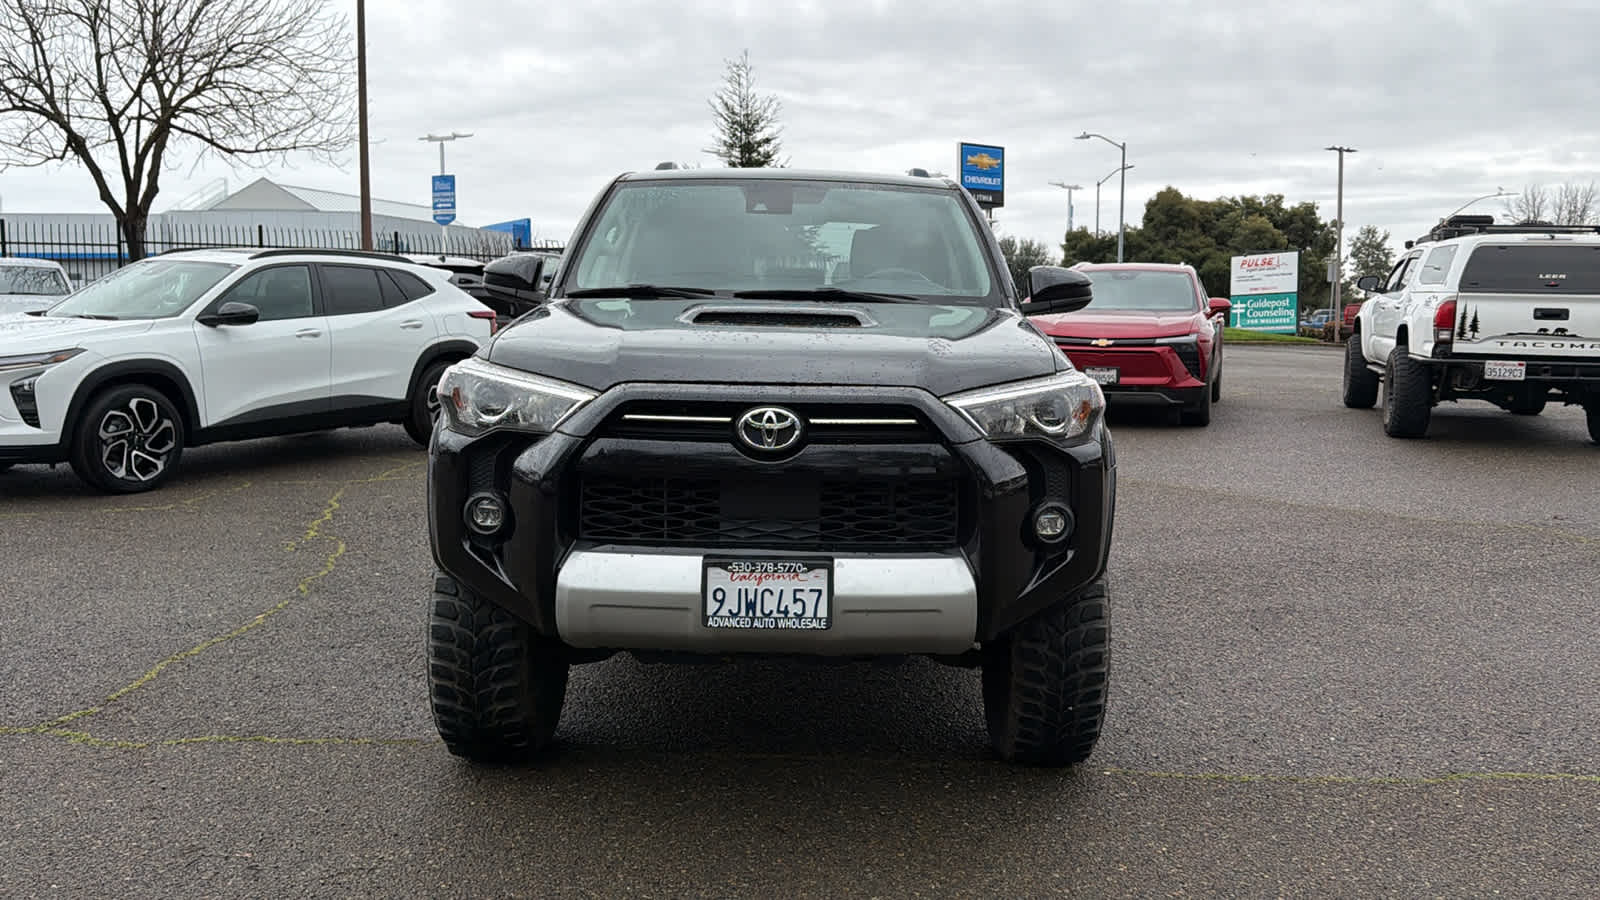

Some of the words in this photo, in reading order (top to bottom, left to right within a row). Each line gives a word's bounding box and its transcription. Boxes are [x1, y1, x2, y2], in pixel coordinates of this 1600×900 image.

[964, 175, 1001, 185] CHEVROLET
[1240, 256, 1274, 268] PULSE
[1247, 298, 1289, 309] Guidepost
[1247, 307, 1295, 318] Counseling
[1496, 341, 1600, 349] TACOMA
[732, 562, 804, 573] 530-378-5770
[730, 572, 808, 585] California
[712, 588, 823, 618] 9JWC457
[707, 616, 751, 628] ADVANCED
[753, 617, 776, 629] AUTO
[777, 618, 827, 630] WHOLESALE
